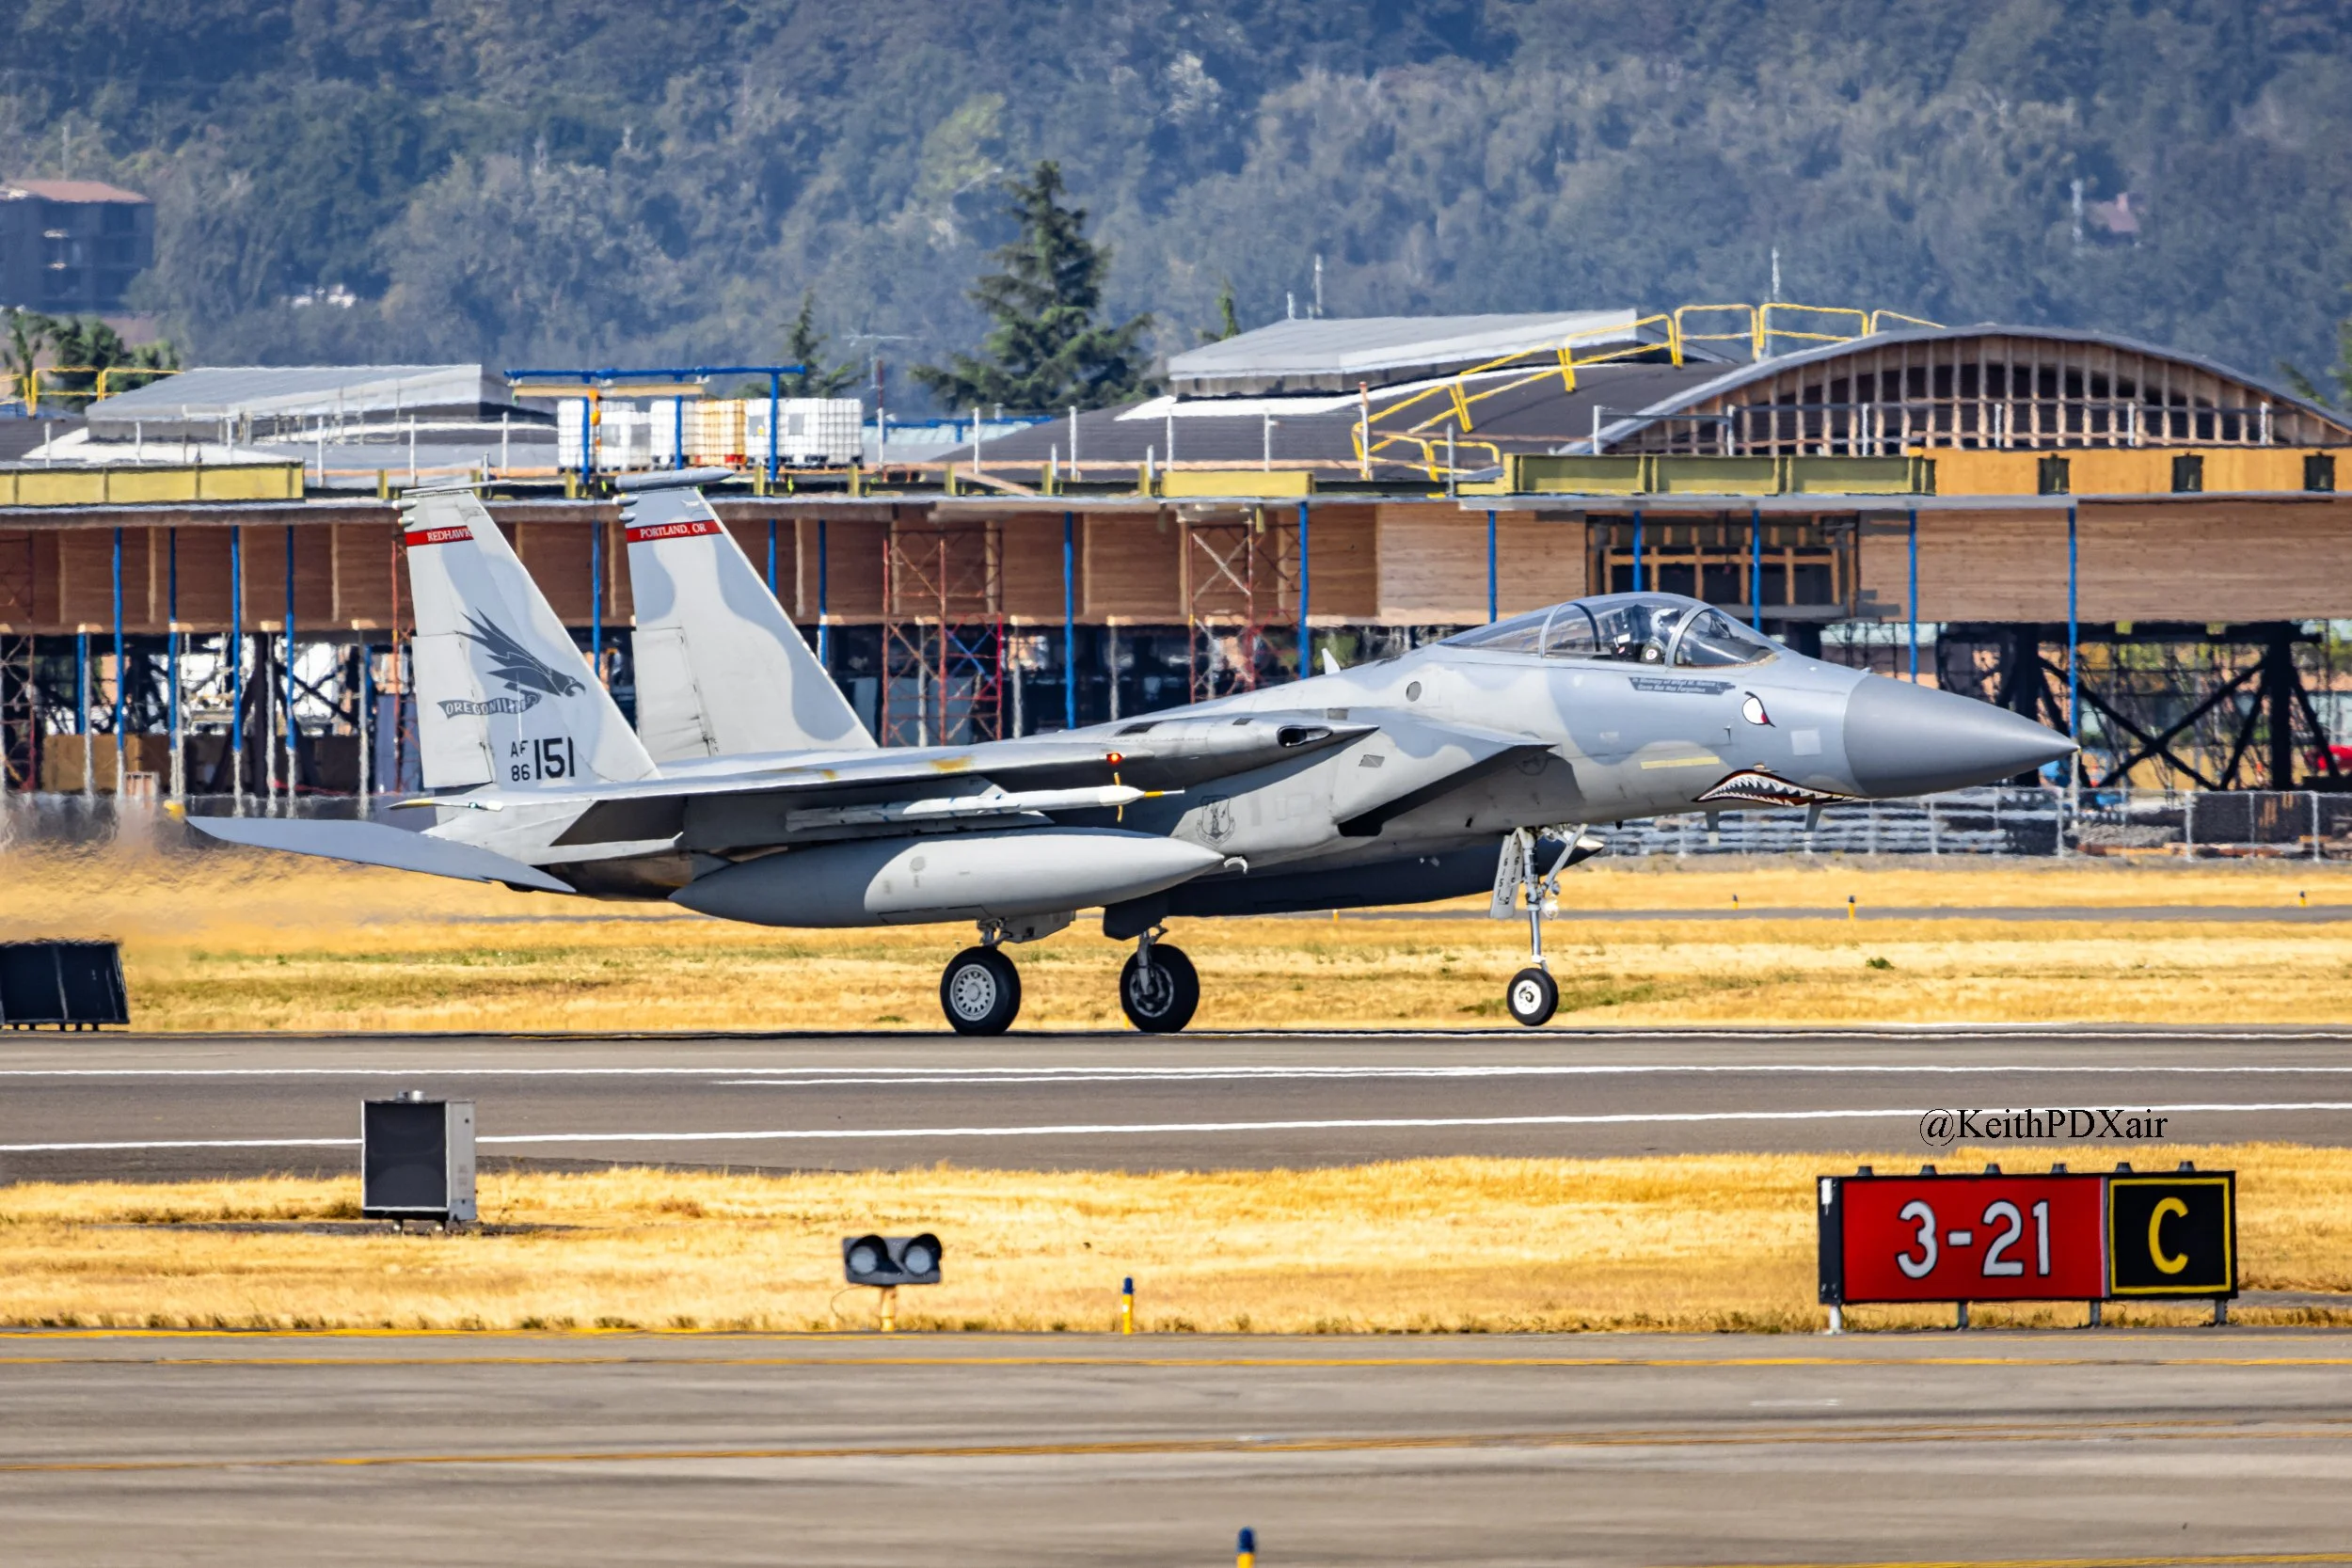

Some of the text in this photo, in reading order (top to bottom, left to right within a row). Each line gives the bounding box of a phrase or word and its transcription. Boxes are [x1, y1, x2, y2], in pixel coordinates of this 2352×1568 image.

[640, 523, 707, 539] PORTLAND, OR
[511, 740, 529, 758] AF
[533, 736, 575, 780] 151
[511, 764, 531, 782] 86
[1895, 1196, 2189, 1279] 3-21 C
